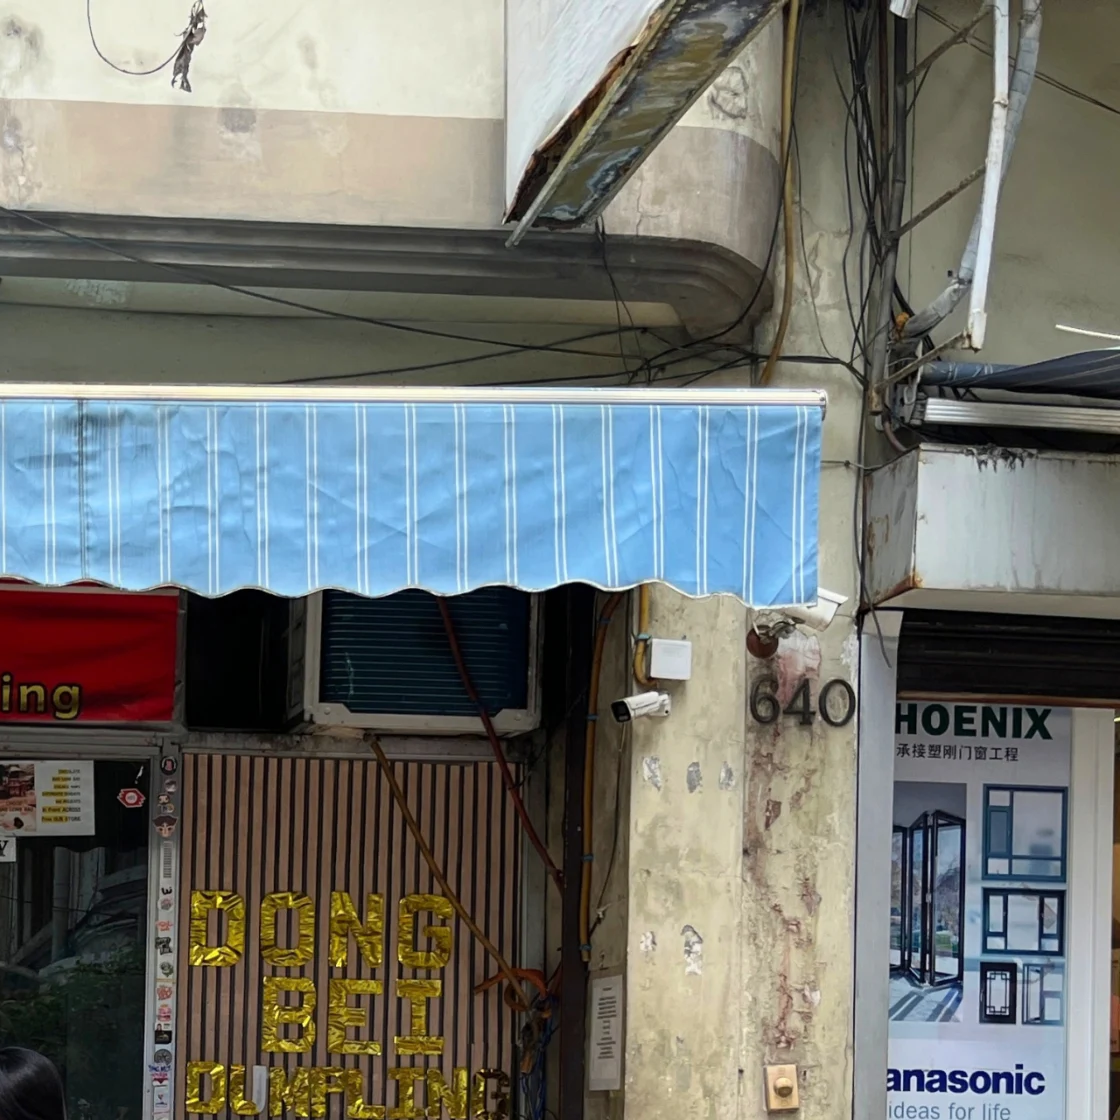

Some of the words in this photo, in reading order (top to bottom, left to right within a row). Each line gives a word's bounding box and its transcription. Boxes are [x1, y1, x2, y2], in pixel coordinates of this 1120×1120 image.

[750, 673, 856, 727] 640
[895, 703, 1053, 740] HOENIX
[896, 743, 1019, 762] 承接塑刚门窗工程
[188, 889, 453, 970] DONG
[260, 975, 444, 1056] BEI
[887, 1063, 1046, 1096] anasonic
[888, 1101, 940, 1120] ideas
[947, 1102, 975, 1120] for
[982, 1103, 1011, 1120] life
